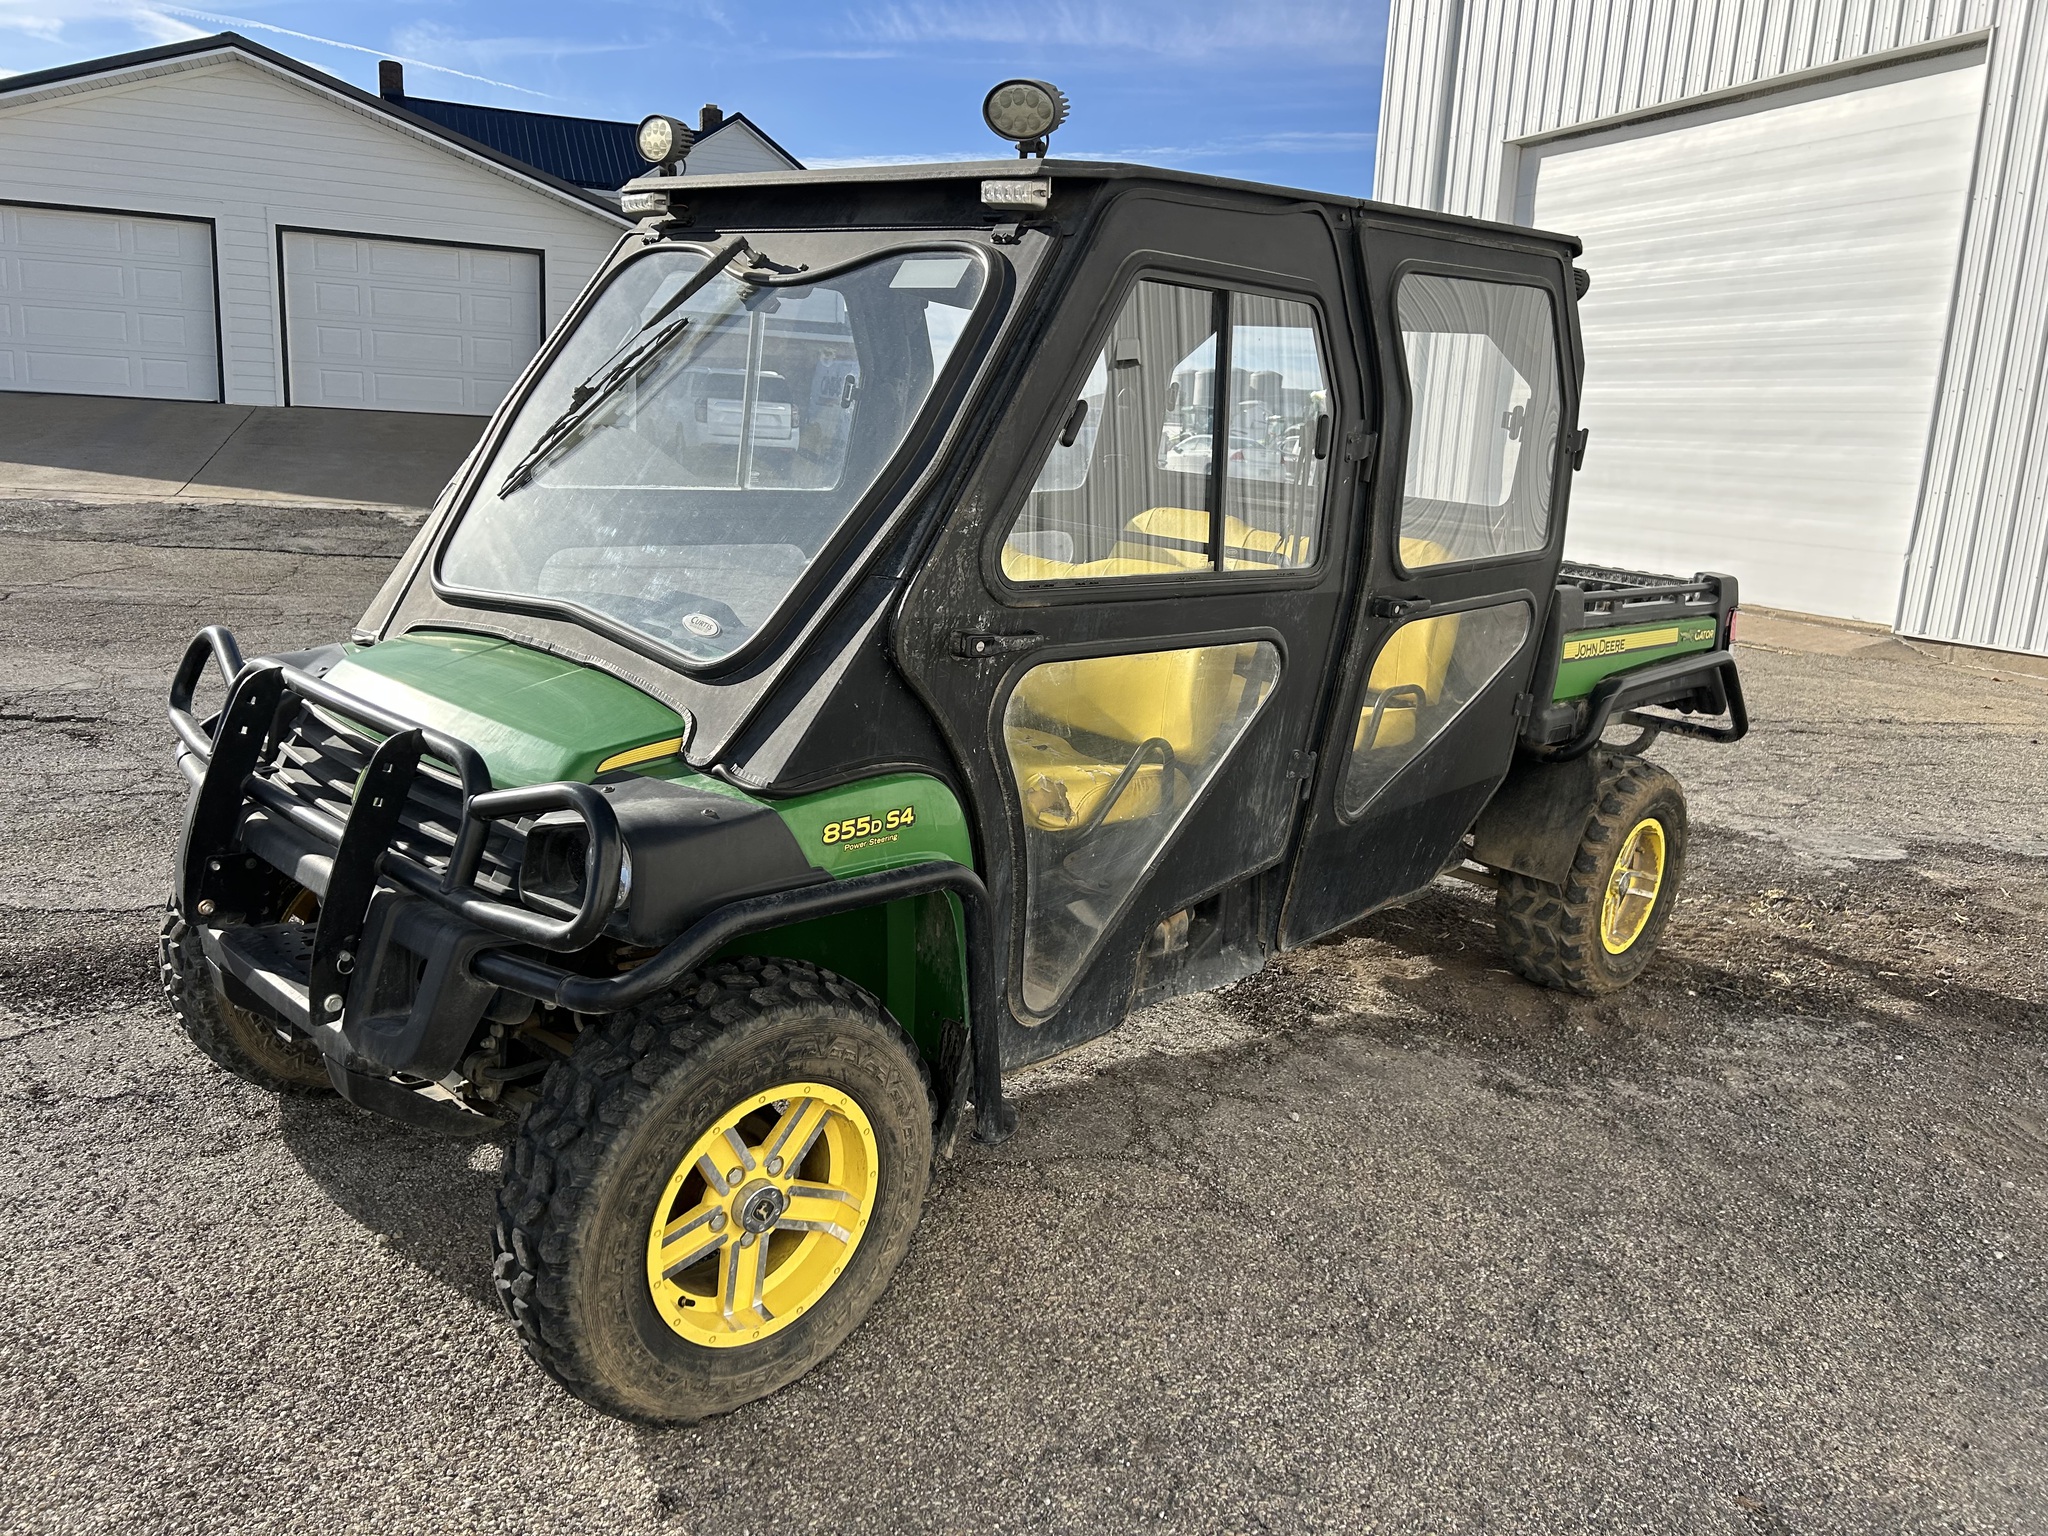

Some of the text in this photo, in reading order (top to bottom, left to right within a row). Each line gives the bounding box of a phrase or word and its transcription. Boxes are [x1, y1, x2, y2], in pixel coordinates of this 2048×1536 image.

[691, 616, 714, 631] CURTIS
[1694, 629, 1715, 641] GATOR
[1574, 638, 1625, 658] JOHN DEERE
[822, 805, 916, 845] 855D S4
[844, 833, 898, 852] Power Steering
